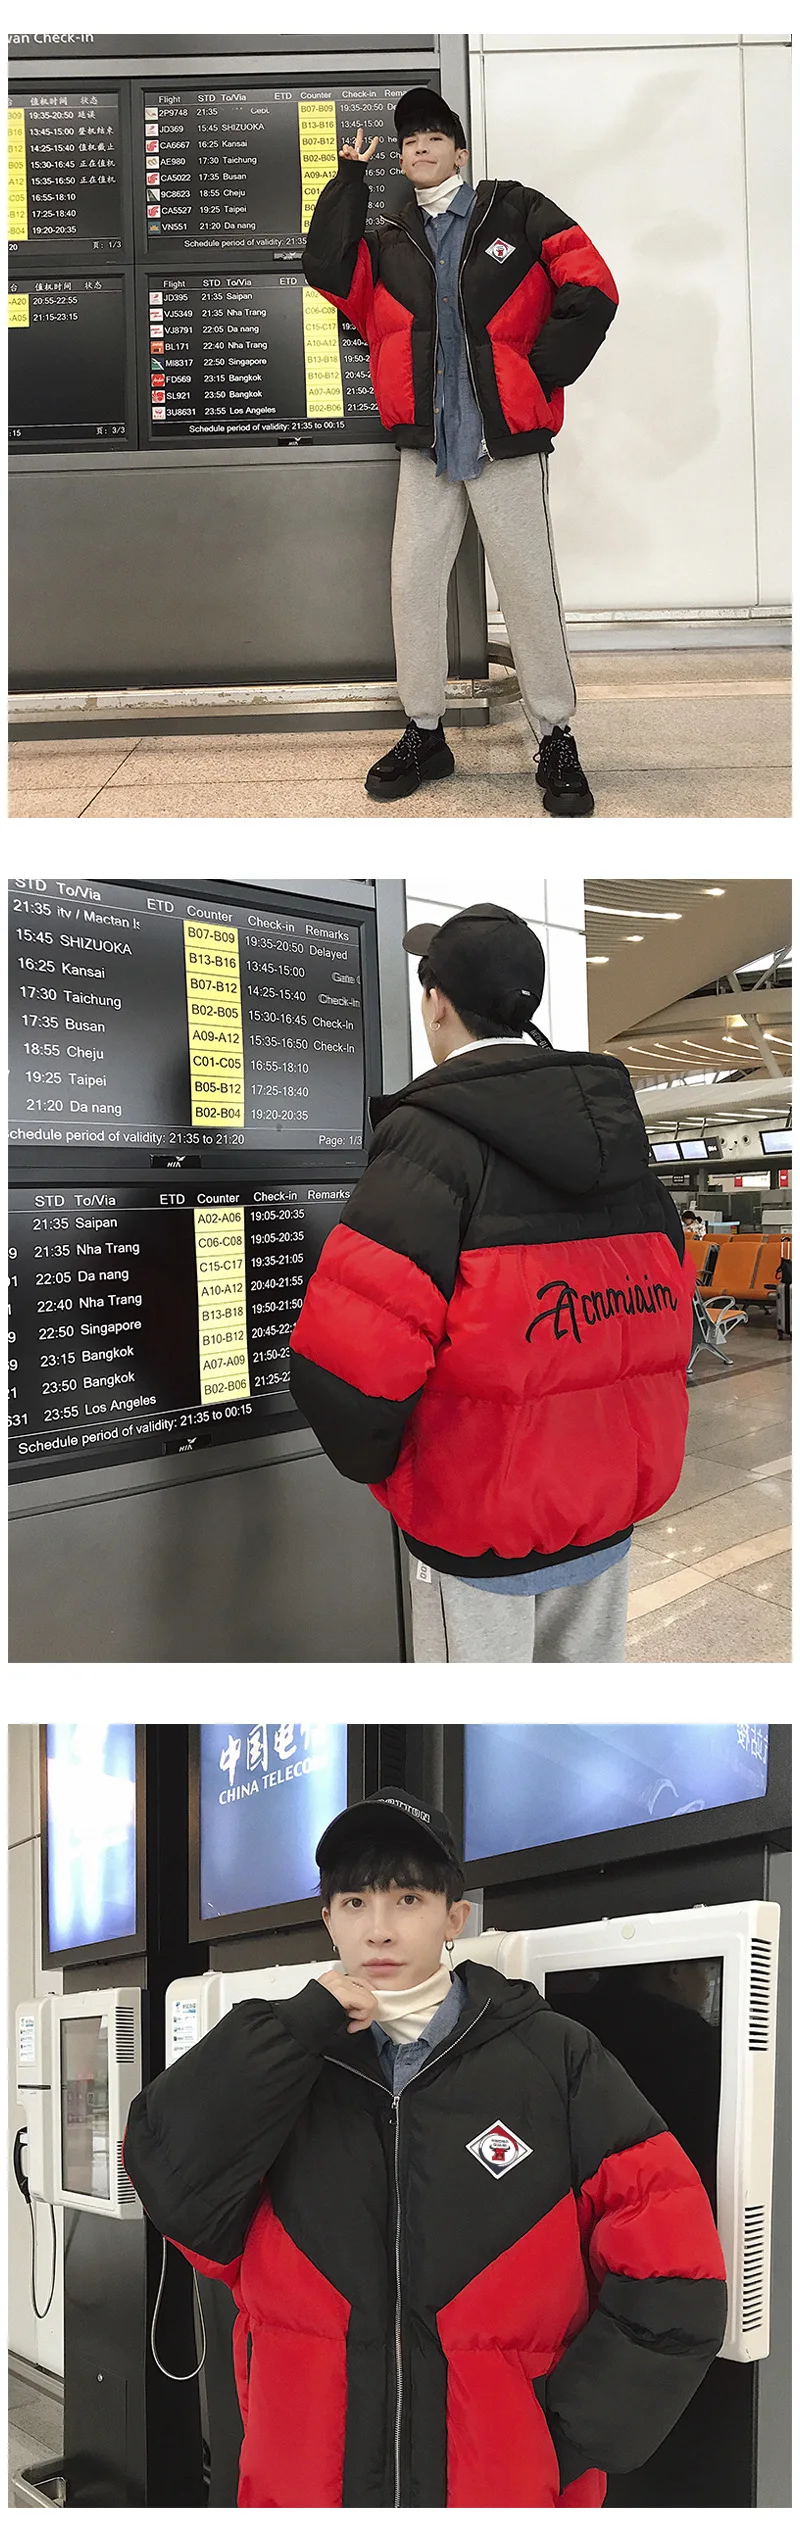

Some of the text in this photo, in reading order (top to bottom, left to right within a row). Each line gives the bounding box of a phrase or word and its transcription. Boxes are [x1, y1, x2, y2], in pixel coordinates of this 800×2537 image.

[159, 90, 377, 104] Flight STD To/Via ETD Counter Check-in
[158, 109, 188, 117] 2P9748
[196, 108, 218, 116] 21:35
[301, 104, 334, 113] B07-B09
[340, 103, 383, 111] 19:35-20:50
[159, 125, 184, 133] JD369
[221, 123, 265, 132] SHIZUOKA
[302, 121, 334, 129] B13-B16
[341, 120, 383, 128] 13:45-15:00
[302, 138, 335, 146] B07-B12
[160, 154, 336, 166] AE980 17:30 Taichung B02-B05
[161, 174, 191, 182] CA5022
[199, 189, 220, 197] 18:55
[223, 189, 246, 198] Cheju
[162, 205, 247, 215] CA5527 19:25 Taipei
[162, 223, 187, 231] VN551
[200, 222, 221, 230] 21:20
[34, 281, 102, 291] 值机时间 状态
[33, 296, 78, 305] 20:55-22:55
[164, 293, 253, 302] JD395 Saipan
[33, 313, 78, 322] 21:15-23:15
[165, 343, 189, 351] BL171
[229, 374, 262, 384] Bangkok
[324, 421, 345, 429] 00:15
[15, 879, 349, 941] STD To/Via ETD Counter Check-in Remarks
[13, 900, 51, 916] 21:35
[84, 910, 130, 929] Mactan
[188, 927, 235, 943] B07-B09
[245, 935, 304, 954] 19:35-20:50
[309, 945, 348, 961] Delayed
[16, 928, 54, 944] 15:45
[60, 934, 132, 955] SHIZUOKA
[189, 953, 236, 969] B13-B16
[246, 961, 305, 978] 13:45-15:00
[18, 957, 55, 973] 16:25
[62, 962, 105, 979] Kansai
[190, 978, 237, 994] B07-B12
[247, 985, 306, 1002] 14:25-15:40
[19, 986, 57, 1001] 17:30
[63, 990, 122, 1010] Taichung
[191, 1004, 238, 1019] B02-B05
[249, 1010, 307, 1026] 15:30-16:45
[22, 1014, 59, 1029] 17:35
[65, 1018, 105, 1033] Busan
[193, 1030, 239, 1044] A09-A12
[250, 1035, 308, 1050] 15:35-16:50
[24, 1043, 309, 1074] 18:55 Cheju C01-C05 16:55-18:10
[26, 1071, 309, 1097] 19:25 Taipei B05-B12 17:25-18:40
[26, 1099, 308, 1121] 21:20 Da nang B02-B04 19:20-20:35
[66, 1130, 105, 1143] period
[108, 1130, 121, 1141] of
[123, 1132, 166, 1145] validity:
[169, 1132, 200, 1144] 21:35
[203, 1134, 213, 1144] to
[215, 1133, 245, 1145] 21:20
[318, 1135, 346, 1148] Page:
[349, 1135, 363, 1145] 1/3
[34, 1189, 350, 1207] STD To/Via ETD Counter Check-in Remarks
[33, 1208, 305, 1231] 21:35 Saipan A02-A06 19:05-20:35
[34, 1231, 305, 1258] 21:35 Nha Trang C06-C08 19:05-20:35
[35, 1253, 304, 1286] 22:05 Da nang C15-C17 19:35-21:05
[37, 1275, 304, 1313] 22:40 Nha Trang A10-A12 20:40-21:55
[38, 1298, 303, 1340] 22:50 Singapore B13-B18 19:50-21:50
[40, 1331, 244, 1368] 23:15 Bangkok B10-B12
[42, 1354, 245, 1395] 23:50 Bangkok A07-A09
[44, 1379, 247, 1422] 23:55 Los Angeles B02-B06
[18, 1403, 253, 1455] Schedule period of validity: 21:35 to 00:15
[219, 1779, 260, 1805] CHINA
